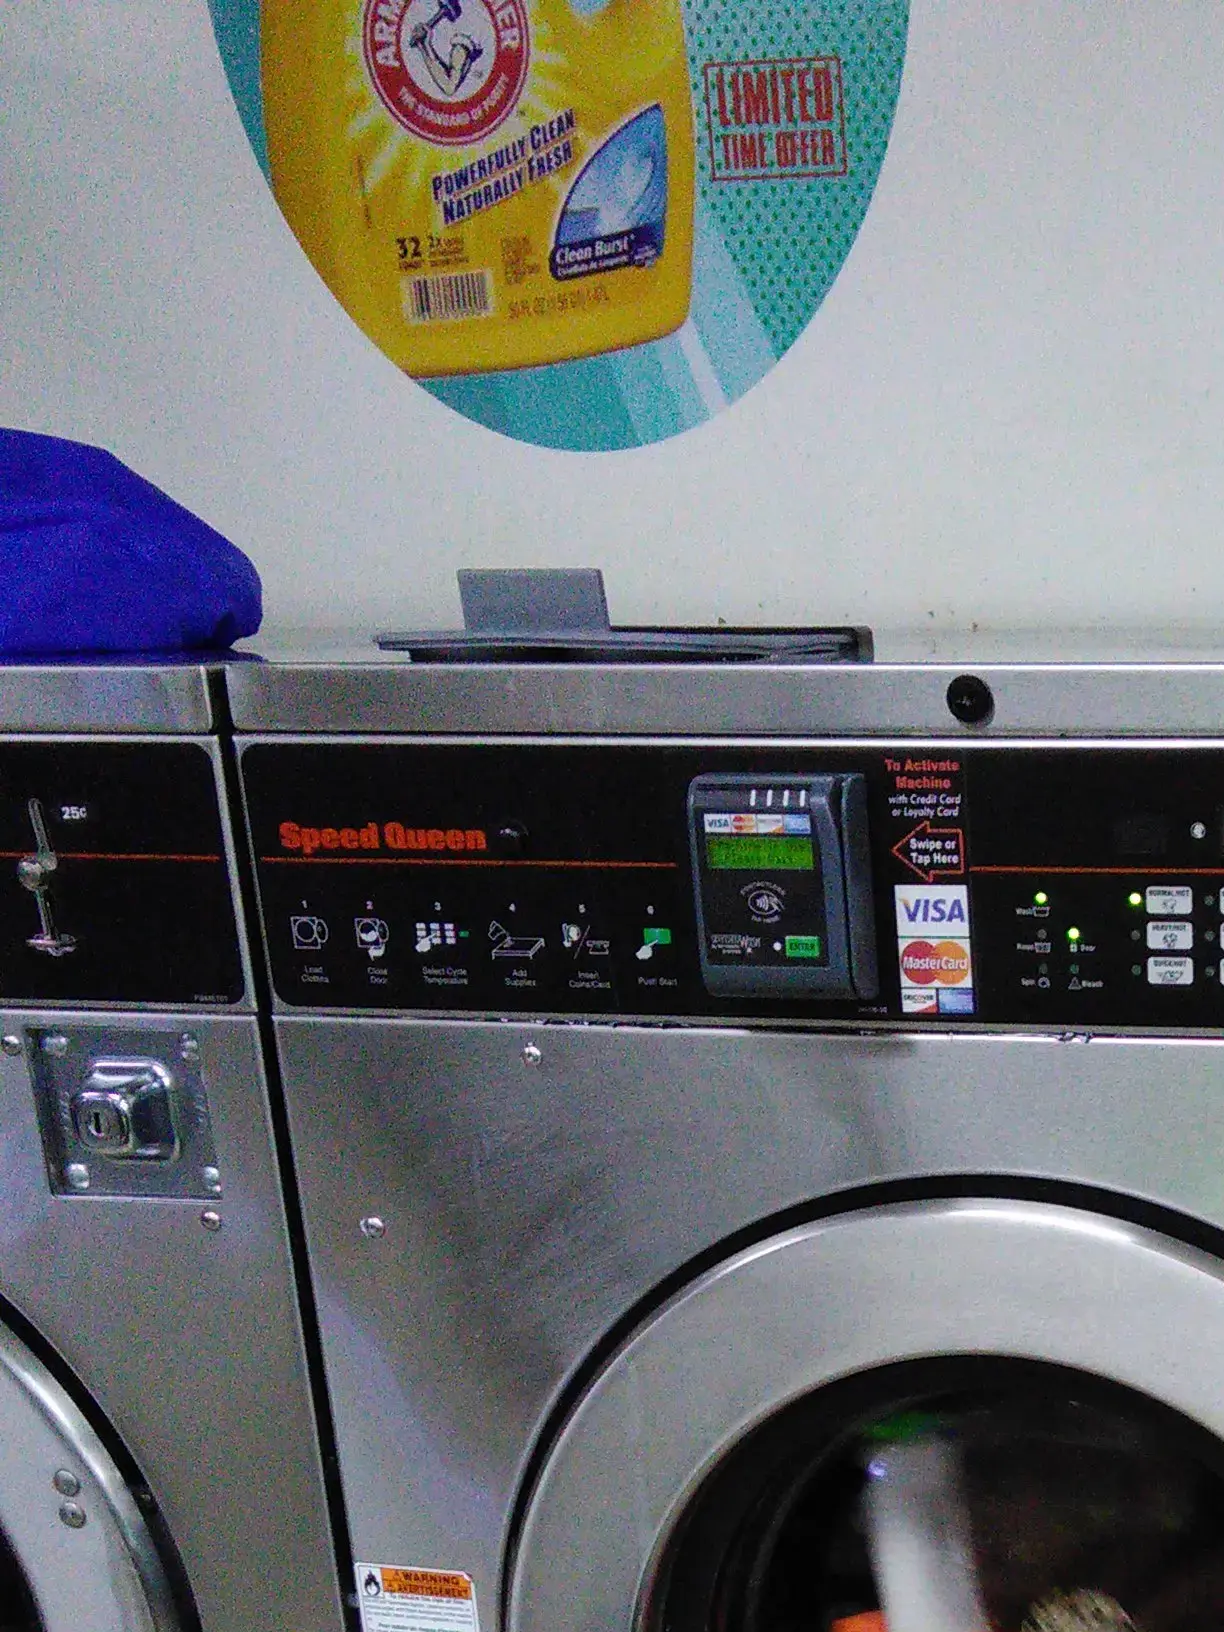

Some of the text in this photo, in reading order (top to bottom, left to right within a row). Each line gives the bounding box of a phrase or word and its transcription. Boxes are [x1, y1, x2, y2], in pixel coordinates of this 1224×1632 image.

[716, 68, 834, 126] LIMITED
[433, 108, 574, 200] POWERFULLY CLEAN
[721, 129, 835, 170] TIME OFFER
[443, 140, 572, 225] NATURALLY FRESH
[397, 236, 422, 258] 32
[555, 246, 592, 264] Clean
[595, 235, 629, 256] Burst
[885, 758, 960, 771] To Activate
[895, 776, 951, 789] Machine
[888, 793, 961, 804] with Credit Card
[891, 806, 959, 818] or Loyalty Card
[707, 818, 730, 828] VISA
[279, 820, 487, 855] Speed Queen
[910, 838, 956, 851] Swipe or
[910, 852, 959, 865] Tap Here
[900, 898, 966, 923] VISA
[902, 956, 968, 970] MasterCard
[422, 966, 468, 977] Select Cycle
[401, 1571, 461, 1586] WARNING
